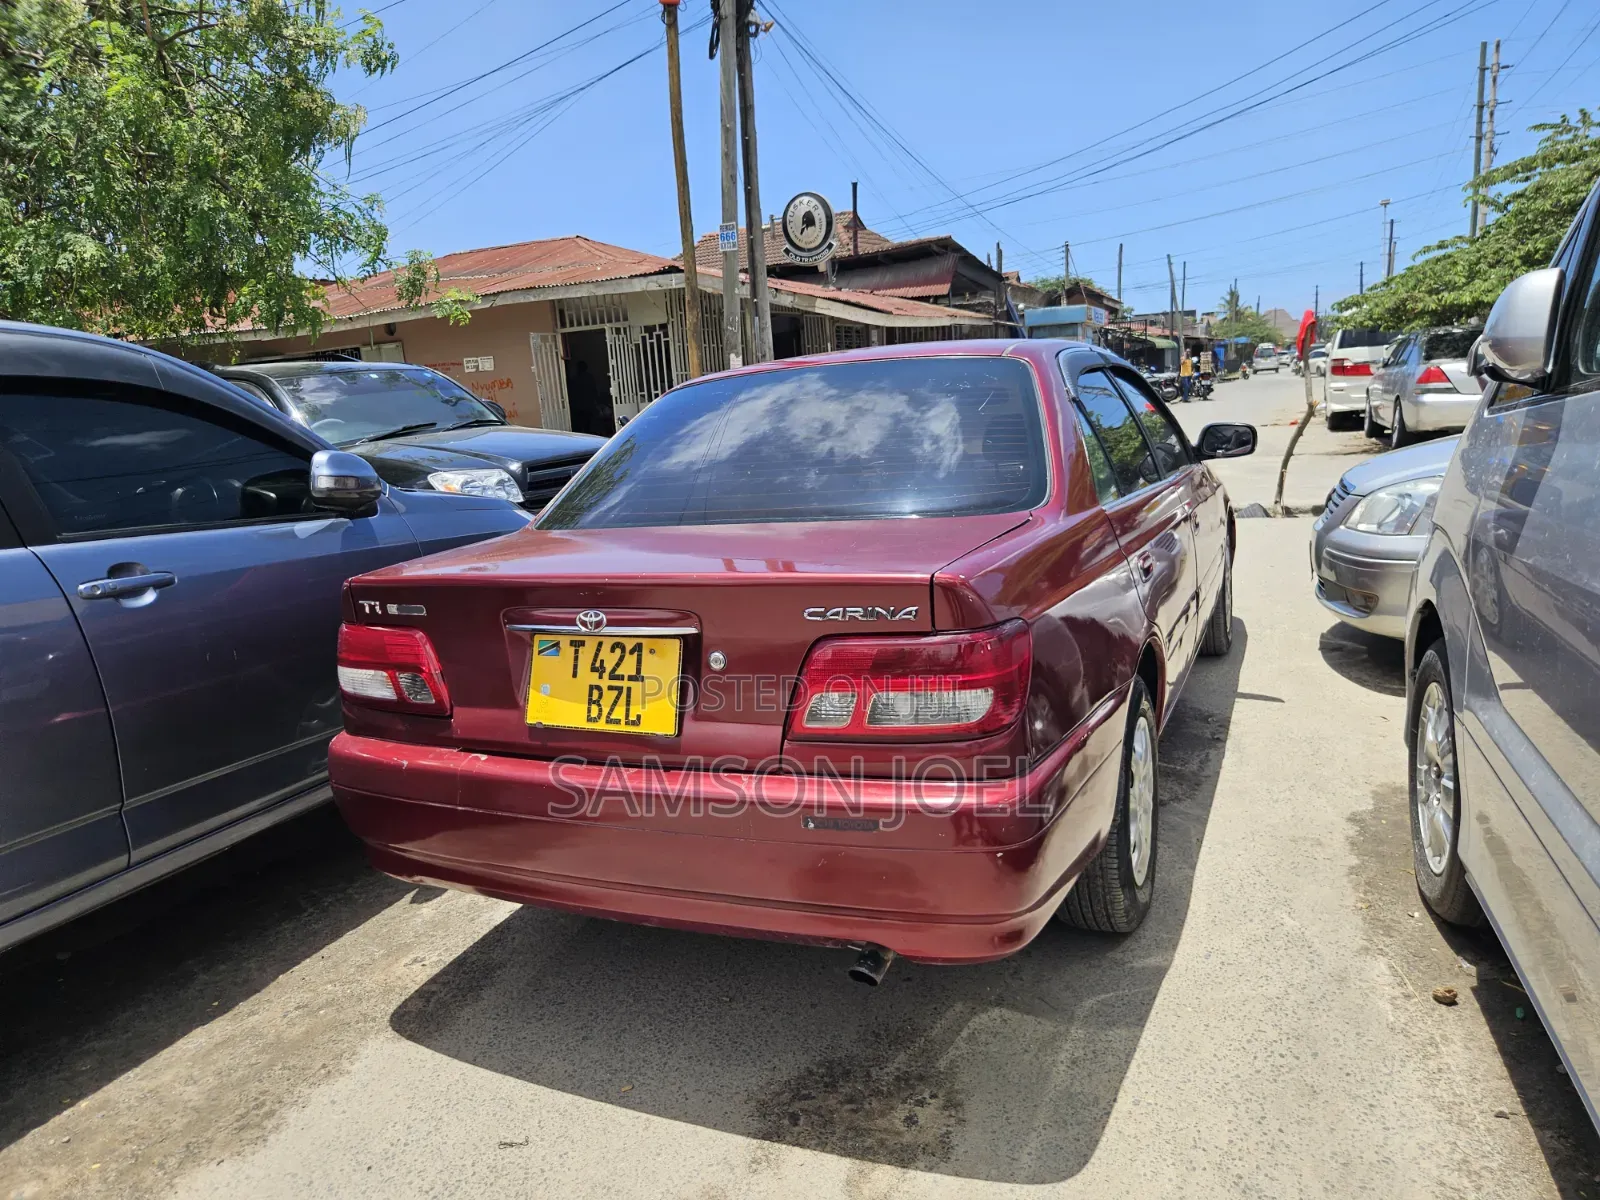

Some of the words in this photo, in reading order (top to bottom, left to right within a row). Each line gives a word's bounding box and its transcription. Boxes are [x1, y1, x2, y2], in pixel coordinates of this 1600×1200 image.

[788, 198, 819, 226] TUSKER
[720, 232, 736, 242] 666
[788, 252, 800, 262] OLD
[803, 606, 919, 621] CARINA
[569, 640, 586, 679] T
[590, 640, 645, 682] 421
[586, 684, 642, 727] BZL
